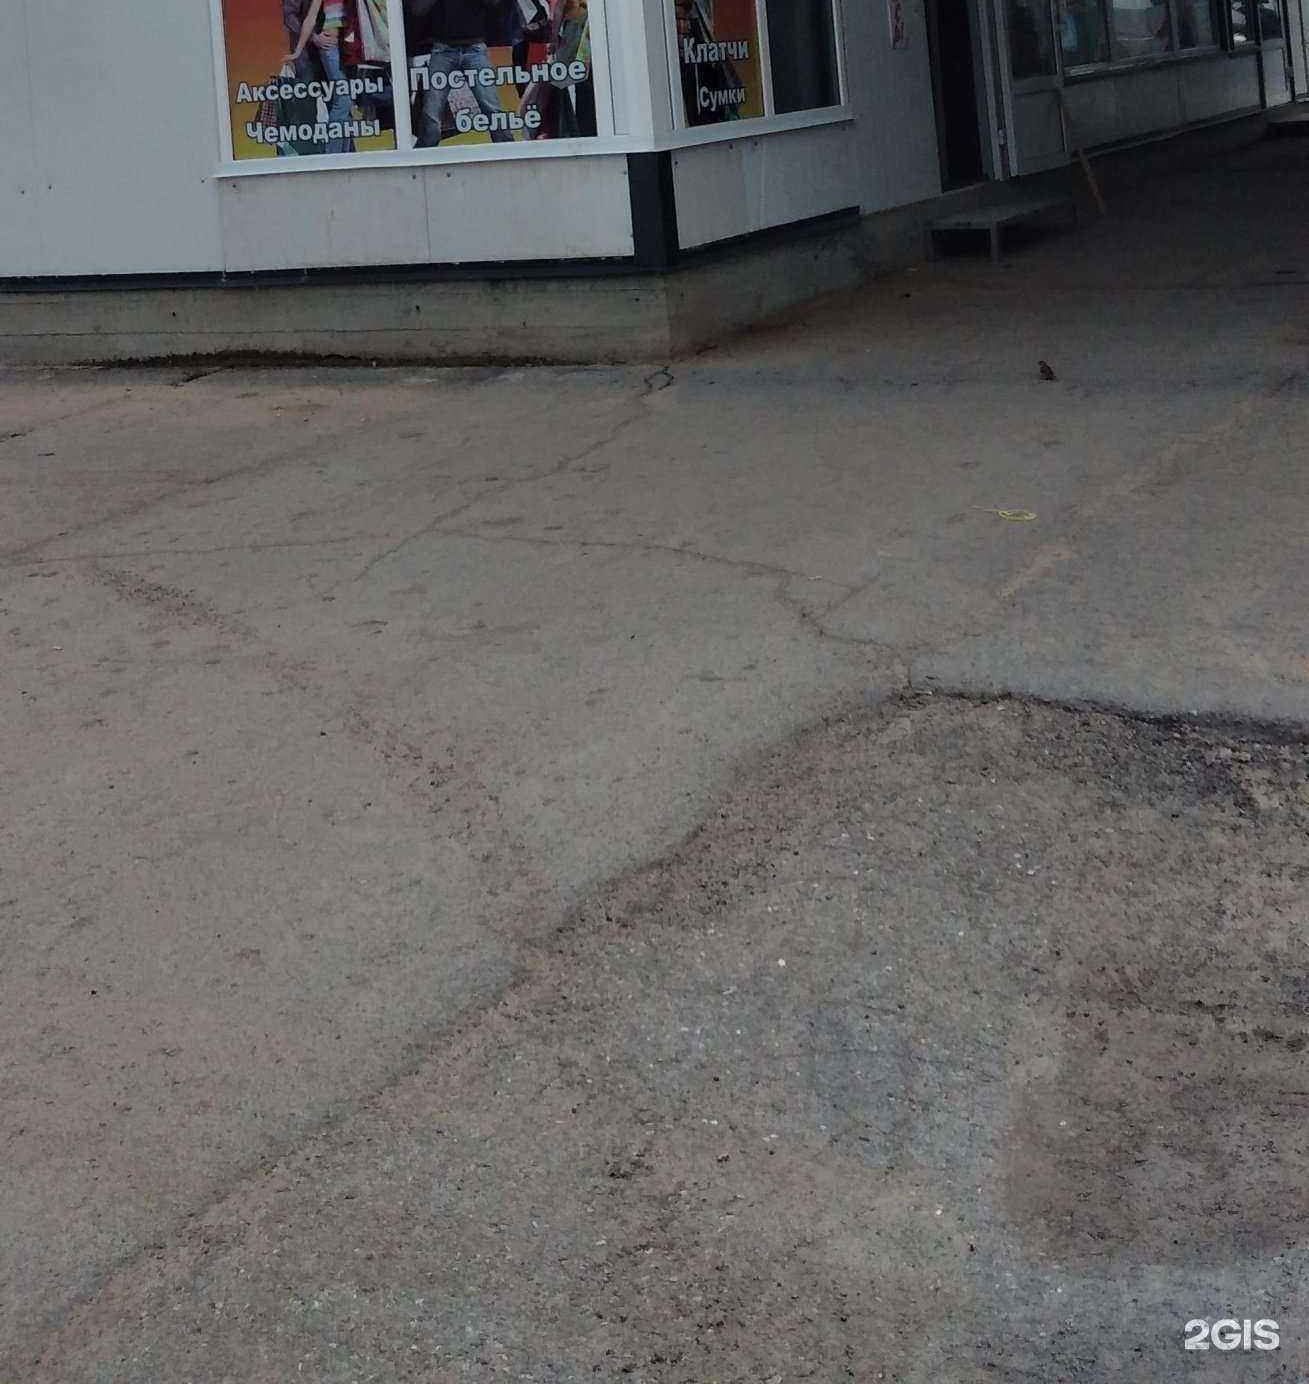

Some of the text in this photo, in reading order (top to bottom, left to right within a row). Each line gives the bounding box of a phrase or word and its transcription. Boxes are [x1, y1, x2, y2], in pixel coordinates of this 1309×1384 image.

[683, 37, 748, 63] Клатчи
[409, 60, 587, 91] Постельное
[236, 78, 384, 104] Аксессуары
[699, 85, 745, 112] Сумки
[246, 119, 380, 144] Чемоданы
[455, 106, 541, 133] бельё
